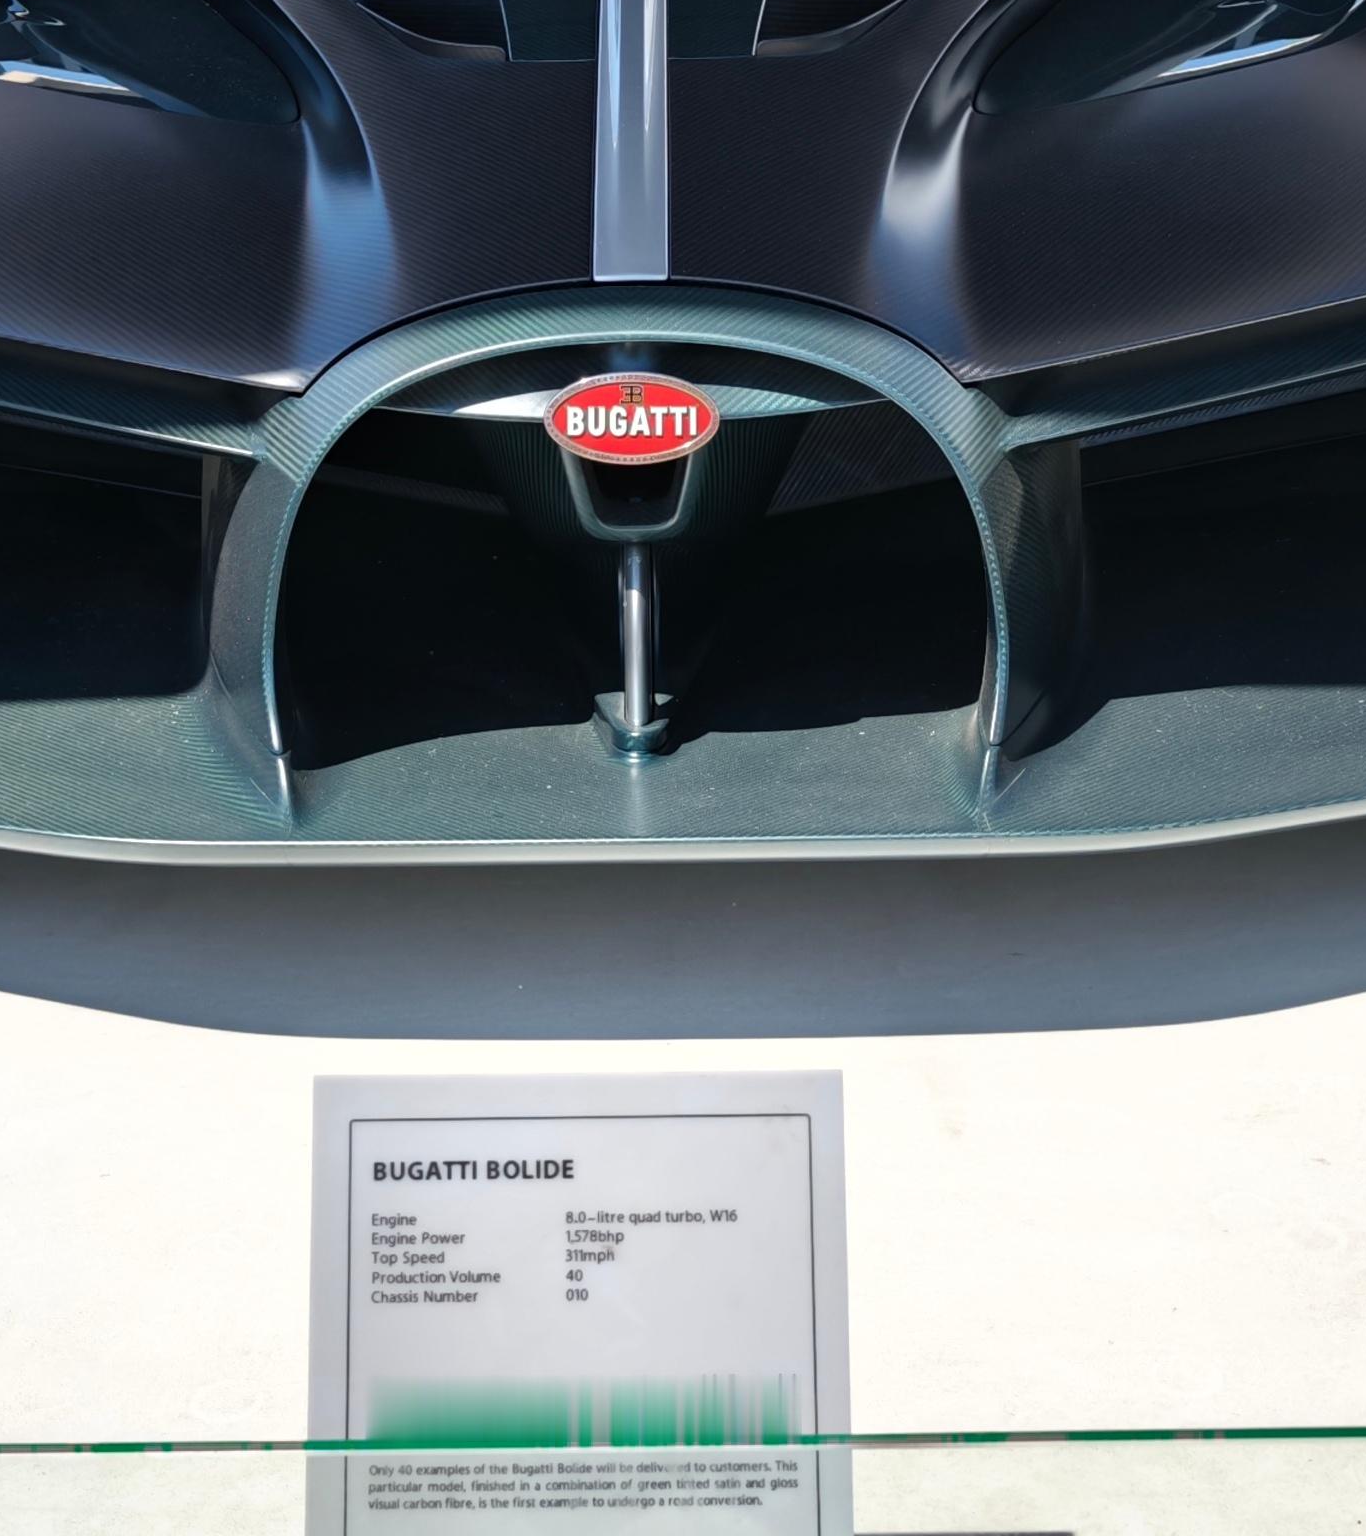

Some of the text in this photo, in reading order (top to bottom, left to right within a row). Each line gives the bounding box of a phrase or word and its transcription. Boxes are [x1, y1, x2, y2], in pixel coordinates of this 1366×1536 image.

[566, 405, 698, 437] BUGATTI
[373, 1159, 575, 1181] BUGATTI BOLIDE
[371, 1213, 417, 1229] Engine
[629, 1210, 661, 1225] quad
[665, 1210, 706, 1224] turbo,
[709, 1209, 738, 1223] W16
[371, 1232, 465, 1247] Engine Power
[565, 1229, 625, 1245] 1,578bhp
[371, 1250, 445, 1266] Top Speed
[565, 1249, 615, 1265] 311mph
[371, 1270, 502, 1285] Production Volume
[565, 1269, 584, 1282] 40
[371, 1290, 479, 1304] Chassis Number
[565, 1288, 589, 1302] 010
[369, 1460, 799, 1477] Only 40 examples of the Bugatti Bolide will be delived to customers. This
[368, 1481, 423, 1495] particular
[427, 1481, 467, 1493] model,
[471, 1480, 516, 1492] finished
[519, 1479, 531, 1491] in
[534, 1482, 541, 1492] a
[545, 1479, 616, 1491] combination
[620, 1479, 633, 1490] of
[637, 1480, 672, 1492] green
[714, 1478, 741, 1490] satin
[745, 1478, 766, 1490] and
[770, 1478, 799, 1491] gloss
[368, 1498, 400, 1510] visual
[403, 1498, 443, 1510] carbon
[445, 1497, 476, 1511] fibre,
[478, 1497, 487, 1509] is
[490, 1497, 510, 1509] the
[512, 1497, 535, 1509] first
[539, 1496, 589, 1510] example
[592, 1496, 605, 1507] to
[607, 1495, 656, 1509] undergo
[658, 1498, 665, 1507] a
